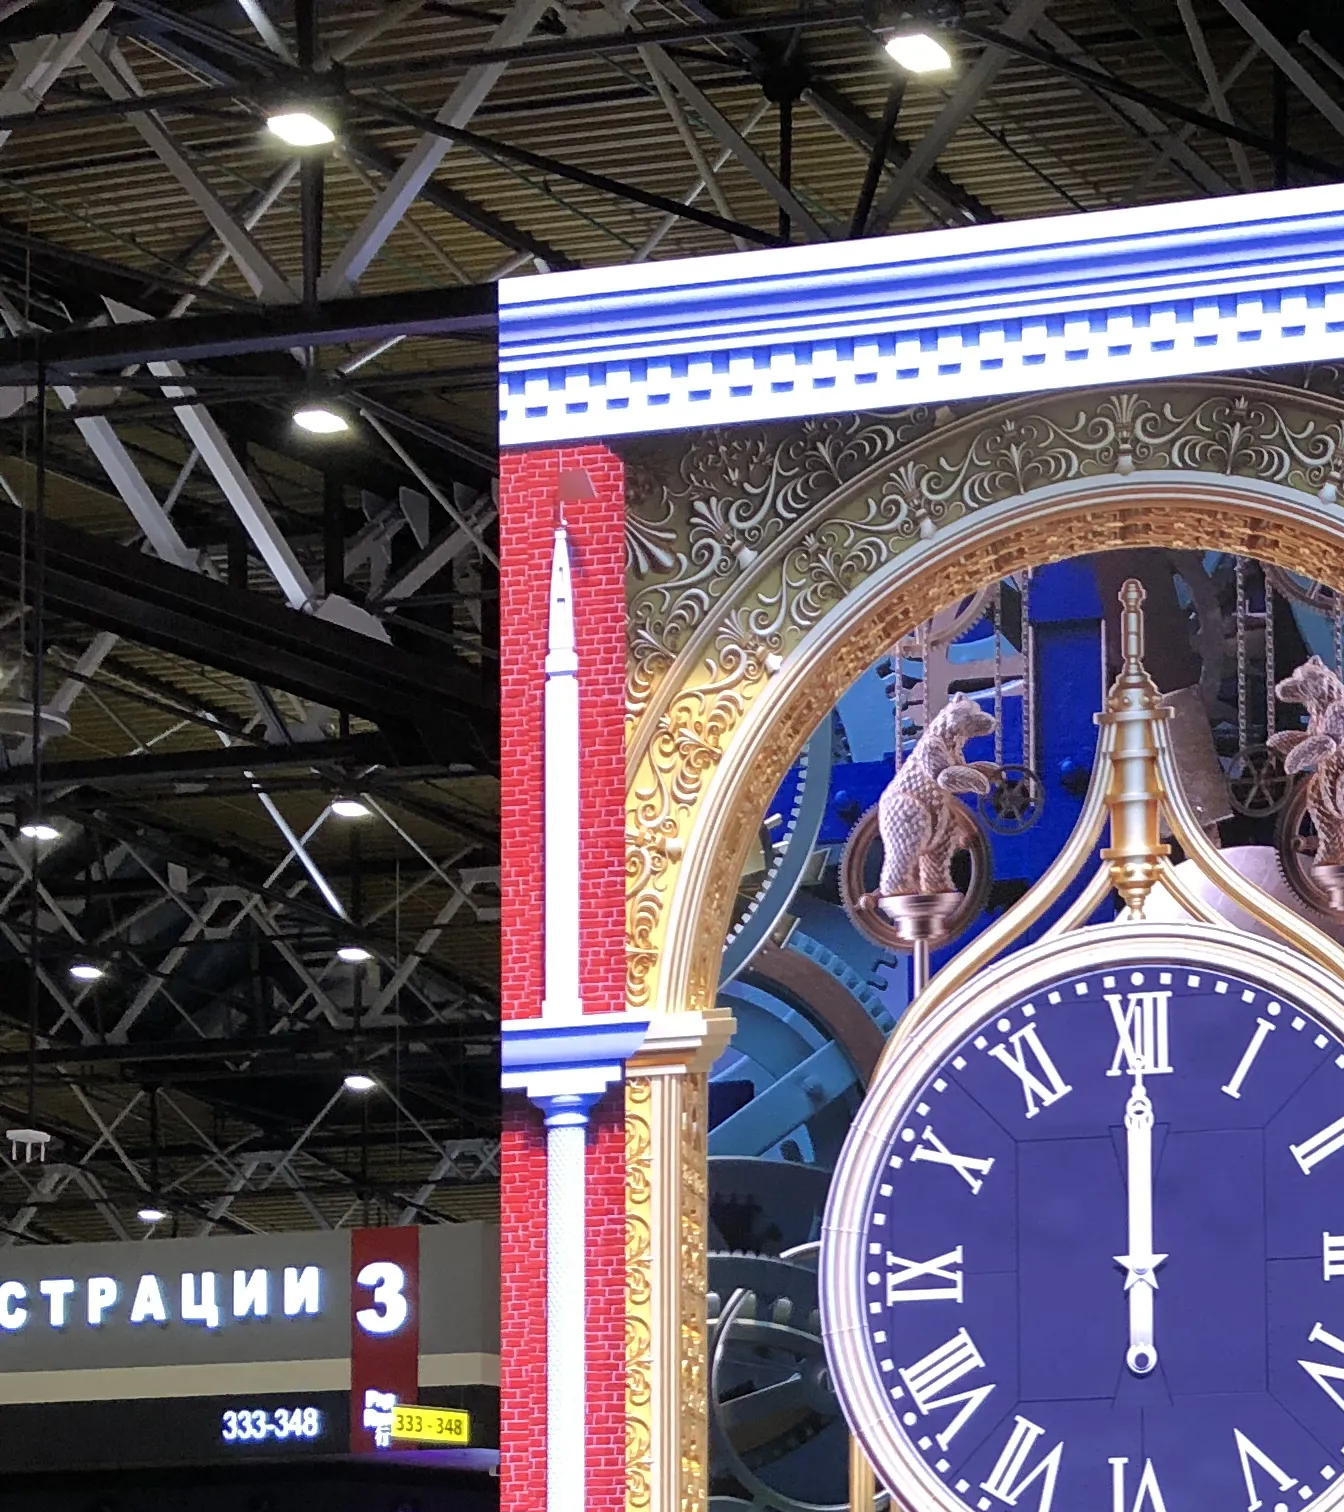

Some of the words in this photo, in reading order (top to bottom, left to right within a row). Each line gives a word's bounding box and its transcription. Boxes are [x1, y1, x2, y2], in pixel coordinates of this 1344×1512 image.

[988, 1021, 1072, 1119] XI
[1104, 991, 1173, 1076] XII
[1220, 1016, 1276, 1099] I
[910, 1125, 995, 1194] X
[0, 1266, 322, 1329] СТРАЦИИ
[355, 1261, 408, 1334] 3
[885, 1245, 964, 1306] IX
[222, 1407, 320, 1443] 333-348
[898, 1326, 996, 1452] VIII
[1232, 1427, 1299, 1512] V
